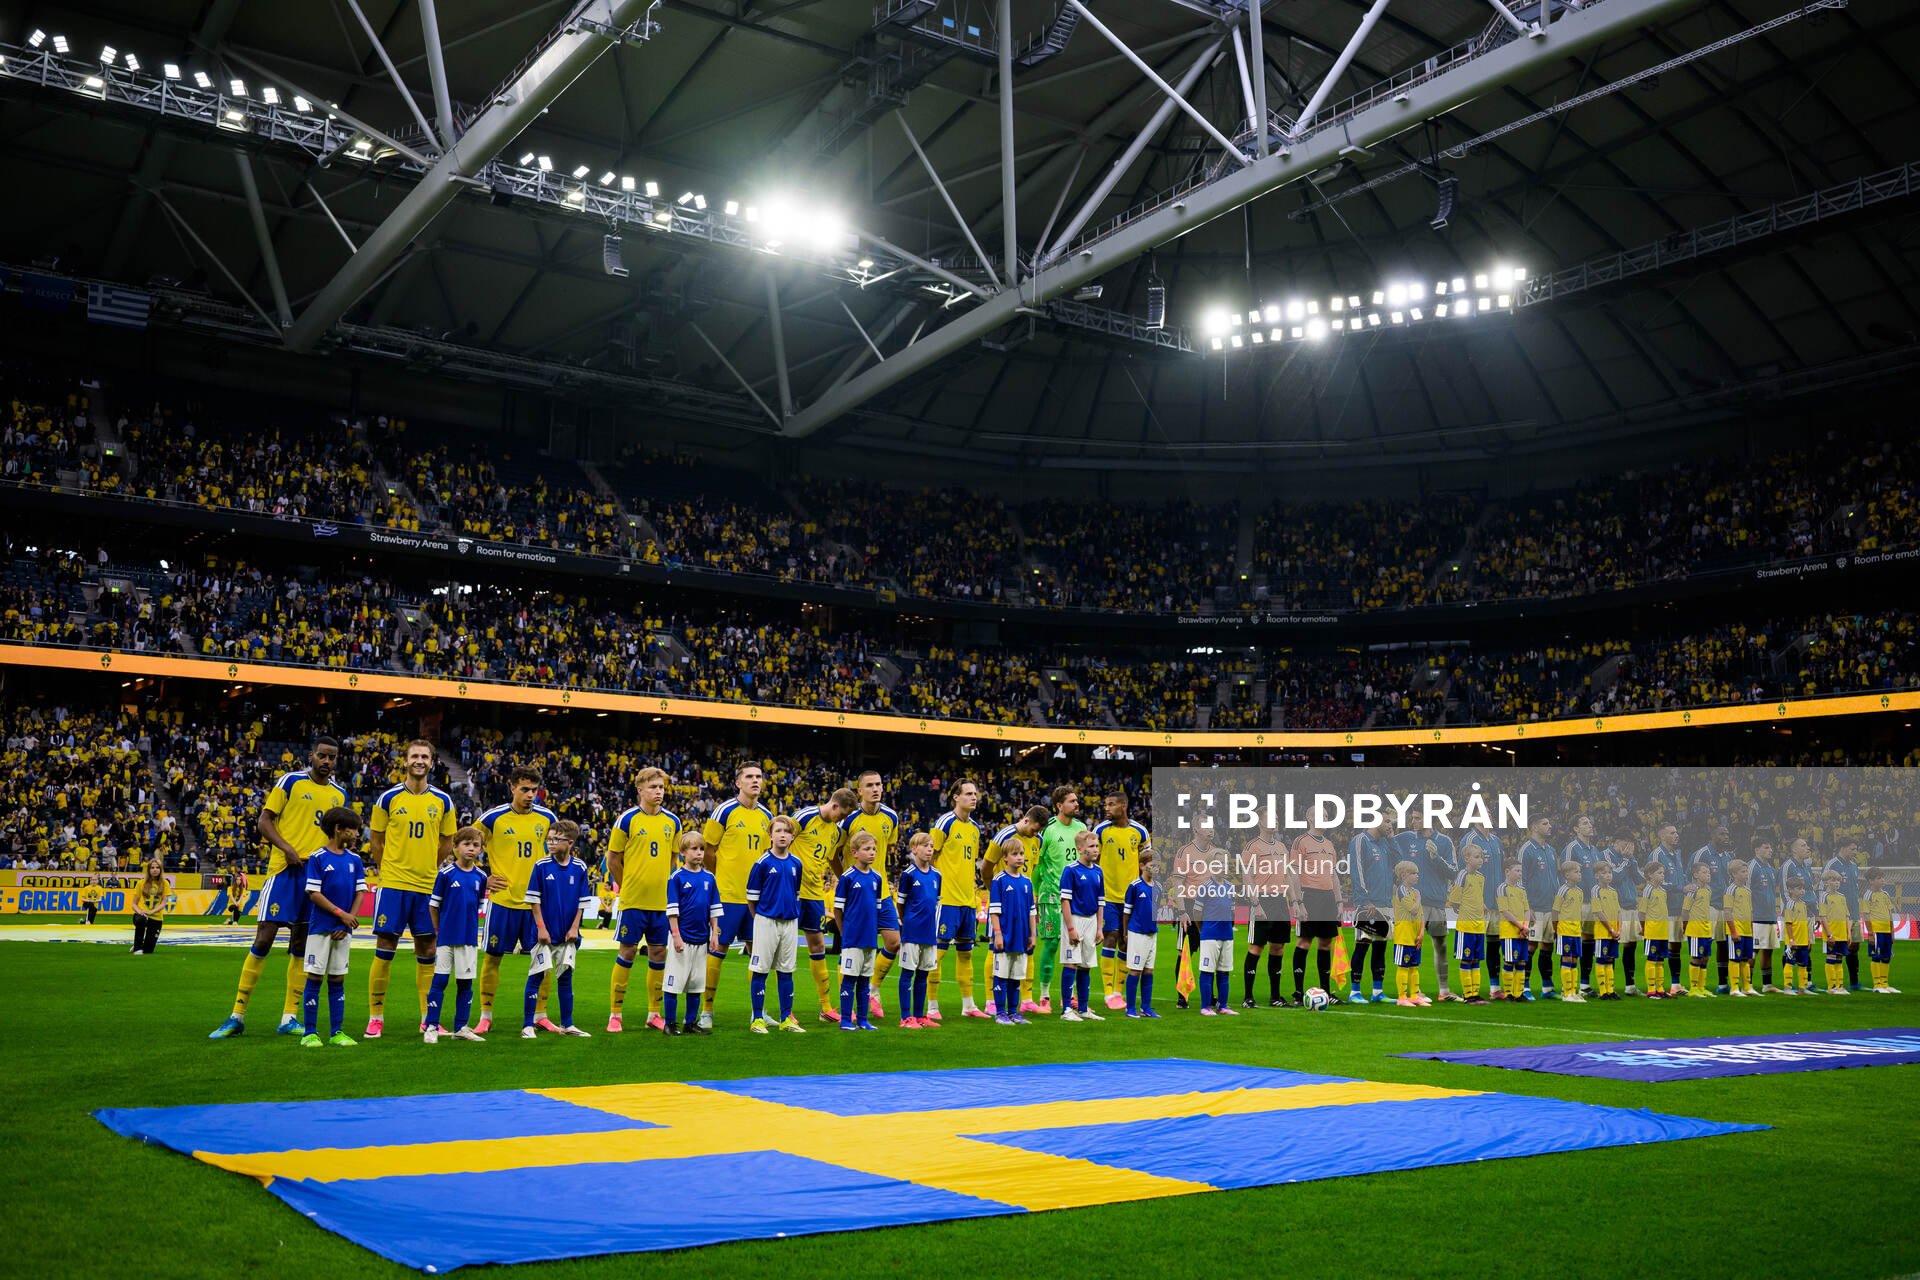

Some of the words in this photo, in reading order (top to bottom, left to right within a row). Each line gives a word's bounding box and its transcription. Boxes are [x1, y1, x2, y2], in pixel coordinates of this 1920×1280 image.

[370, 532, 420, 549] Strawberry
[422, 539, 449, 551] Arena
[476, 545, 502, 558] Room
[503, 548, 515, 559] for
[516, 550, 556, 564] emotions
[1757, 566, 1801, 578] Strawberry
[1802, 561, 1828, 572] Arena
[1854, 556, 1880, 565] Room
[1881, 552, 1894, 561] for
[1178, 616, 1219, 625] Strawberry
[1266, 615, 1289, 623] Room
[1289, 615, 1300, 623] for
[409, 821, 425, 839] 10
[517, 841, 533, 859] 18
[650, 841, 658, 858] 8
[748, 833, 760, 850] 17
[813, 844, 827, 859] 21
[963, 845, 972, 860] 19
[1065, 847, 1077, 861] 23
[1118, 847, 1125, 861] 4
[18, 889, 126, 912] GREKLND
